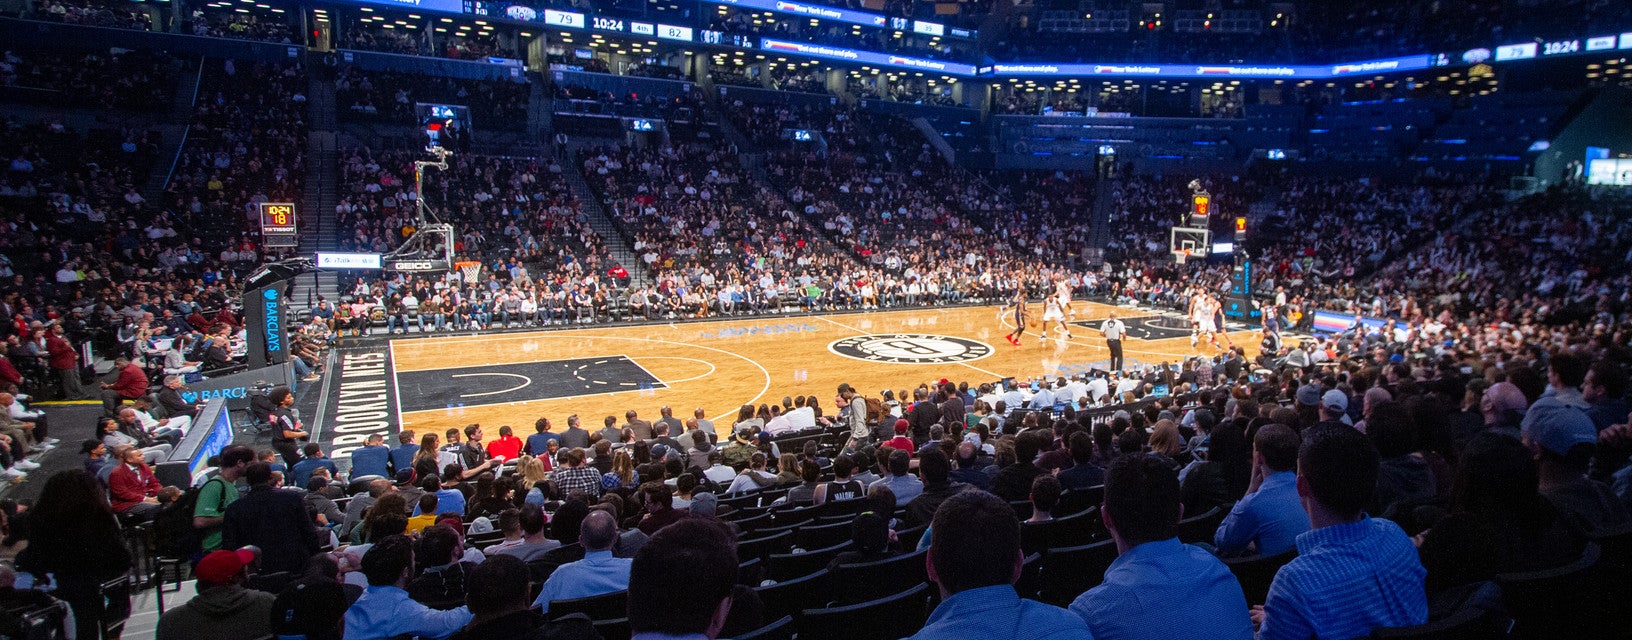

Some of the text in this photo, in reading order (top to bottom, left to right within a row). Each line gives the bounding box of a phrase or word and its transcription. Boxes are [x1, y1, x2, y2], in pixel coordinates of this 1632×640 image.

[821, 8, 842, 18] Lottery
[558, 14, 573, 24] 79
[593, 17, 624, 31] 10:24
[669, 28, 682, 37] 82
[274, 214, 286, 225] 18
[395, 262, 431, 270] GEICO
[265, 301, 280, 352] BARCLAYS
[342, 353, 385, 378] NETS
